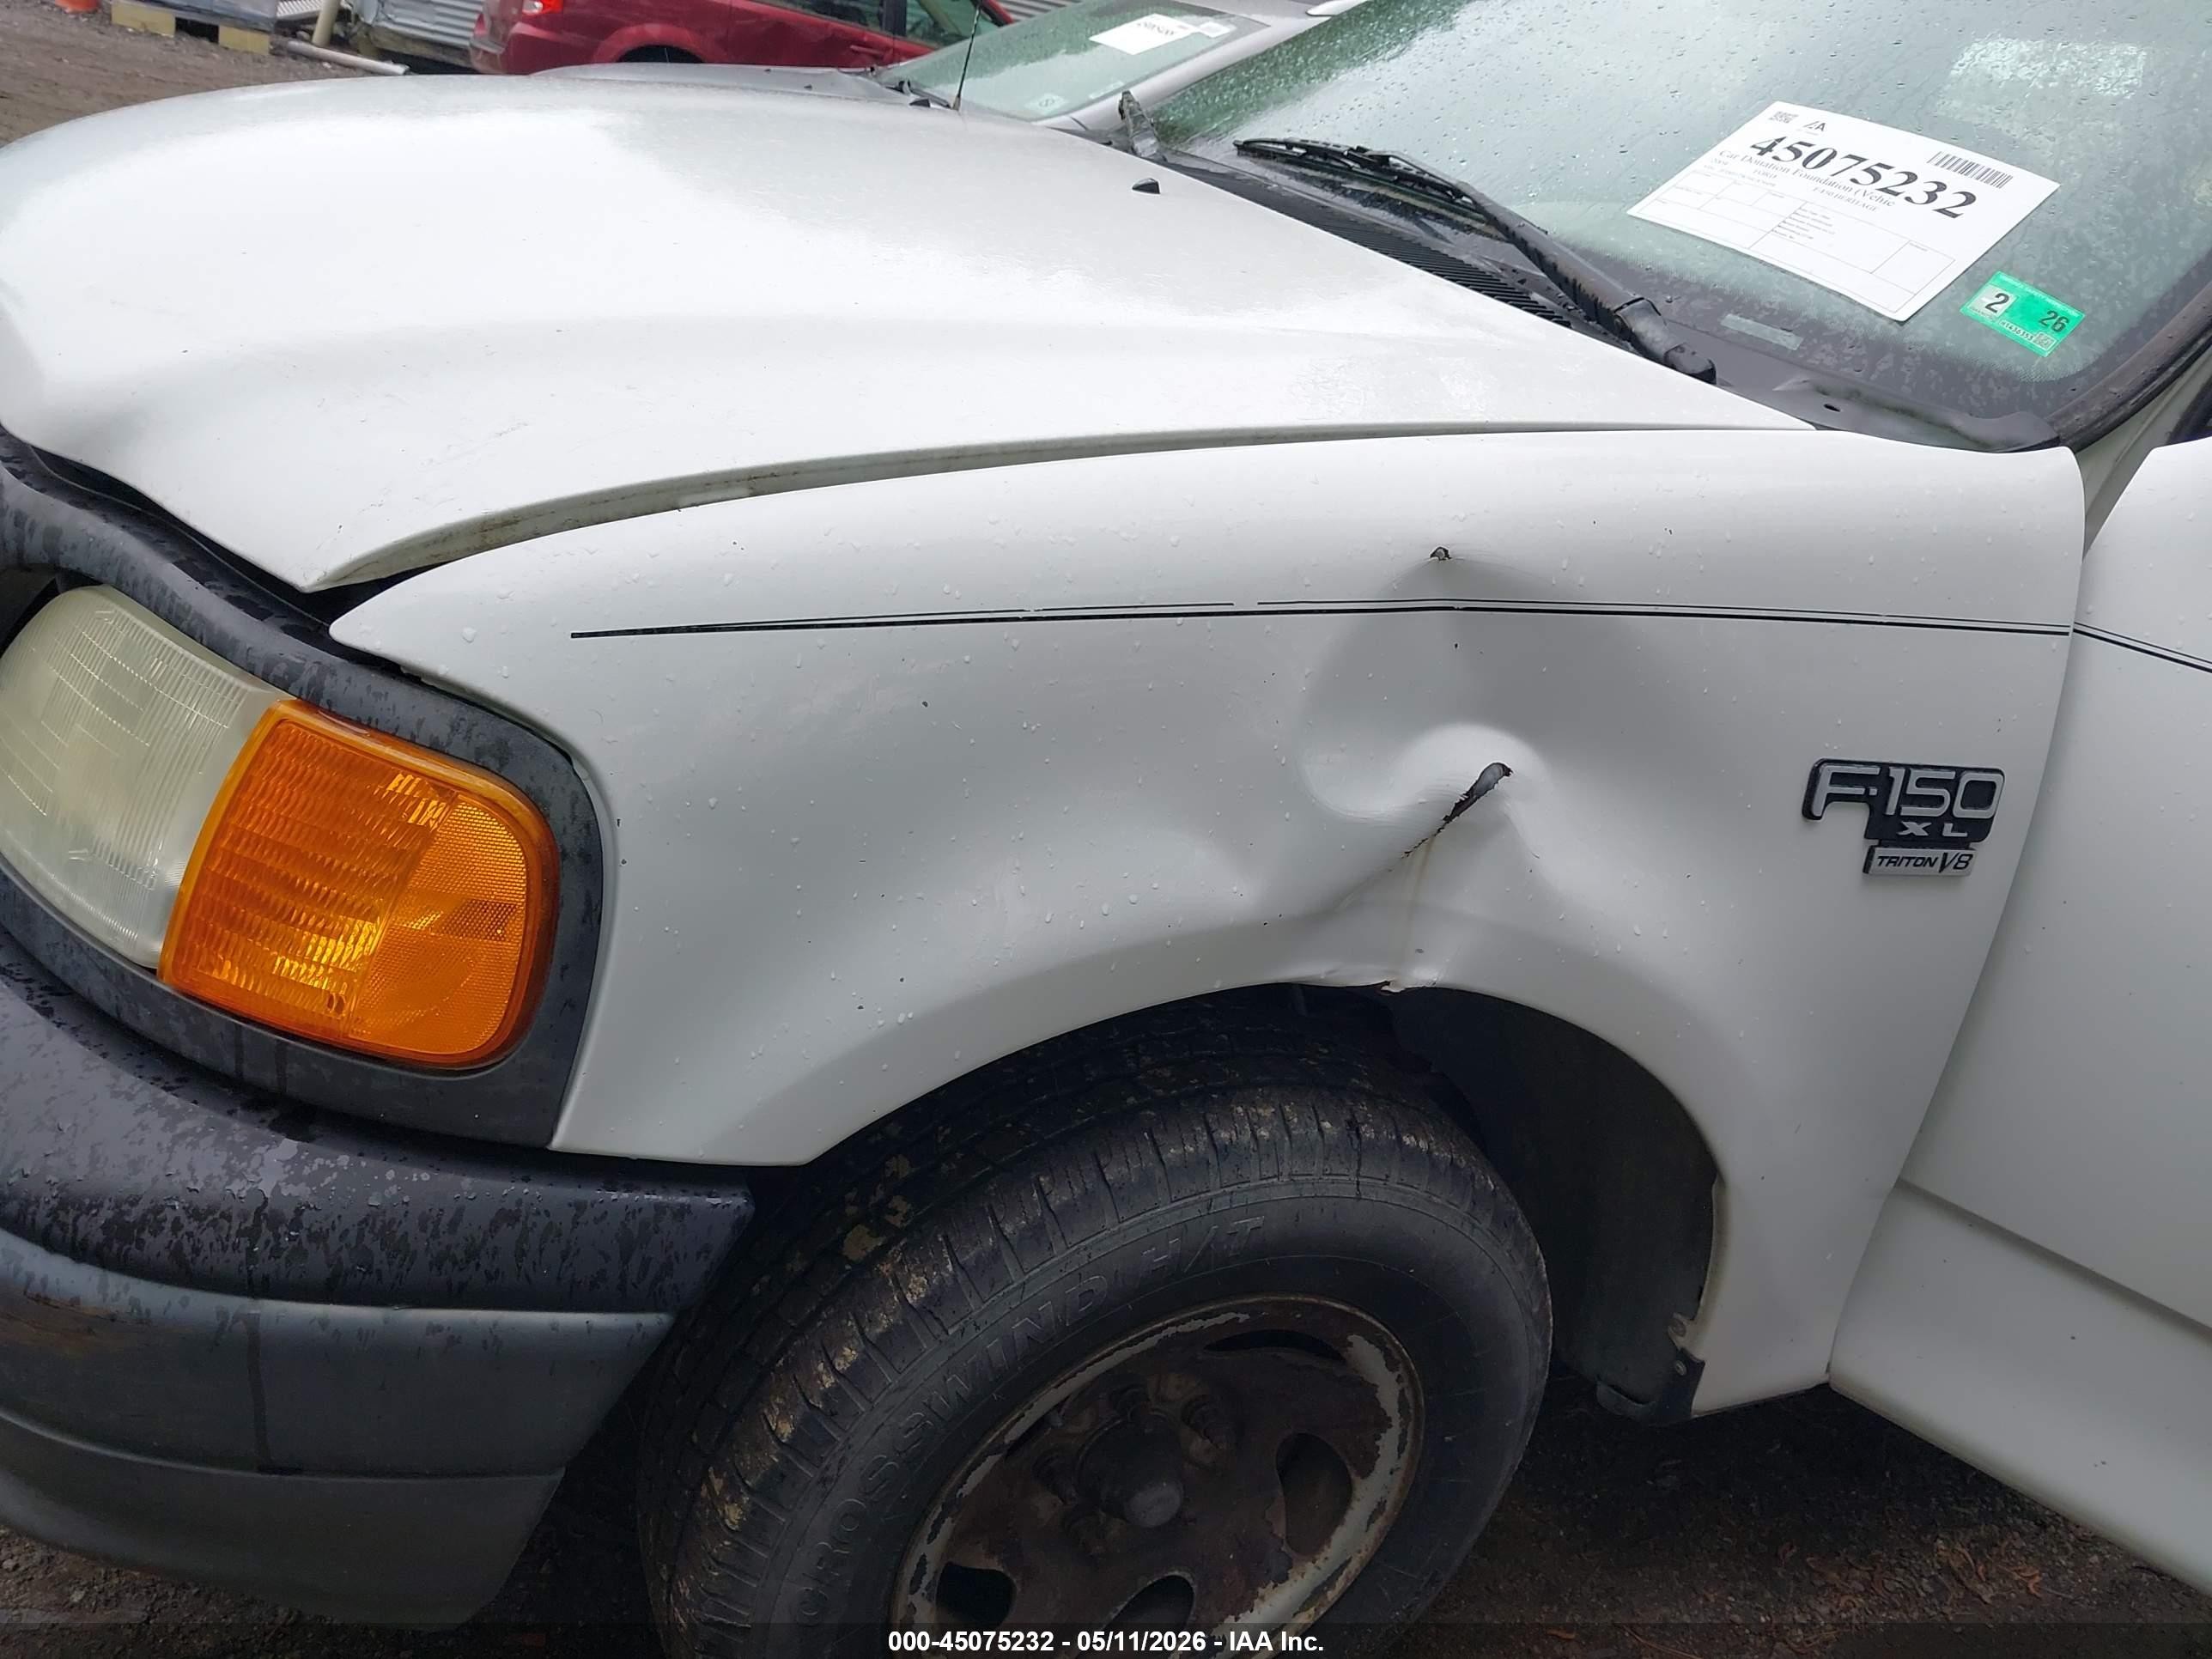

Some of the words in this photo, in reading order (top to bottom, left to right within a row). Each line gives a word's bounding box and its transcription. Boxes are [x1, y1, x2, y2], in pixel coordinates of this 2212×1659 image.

[1719, 149, 1740, 160] Car
[1741, 155, 1790, 173] Donation
[1792, 169, 1853, 193] Foundation
[1750, 137, 1977, 219] 45075232
[1984, 292, 2009, 314] 2
[2038, 310, 2070, 333] 26
[1897, 820, 1969, 837] XL
[1877, 854, 1939, 868] TRITON
[1938, 851, 1974, 873] V8
[799, 1273, 1110, 1620] CROSSWIND
